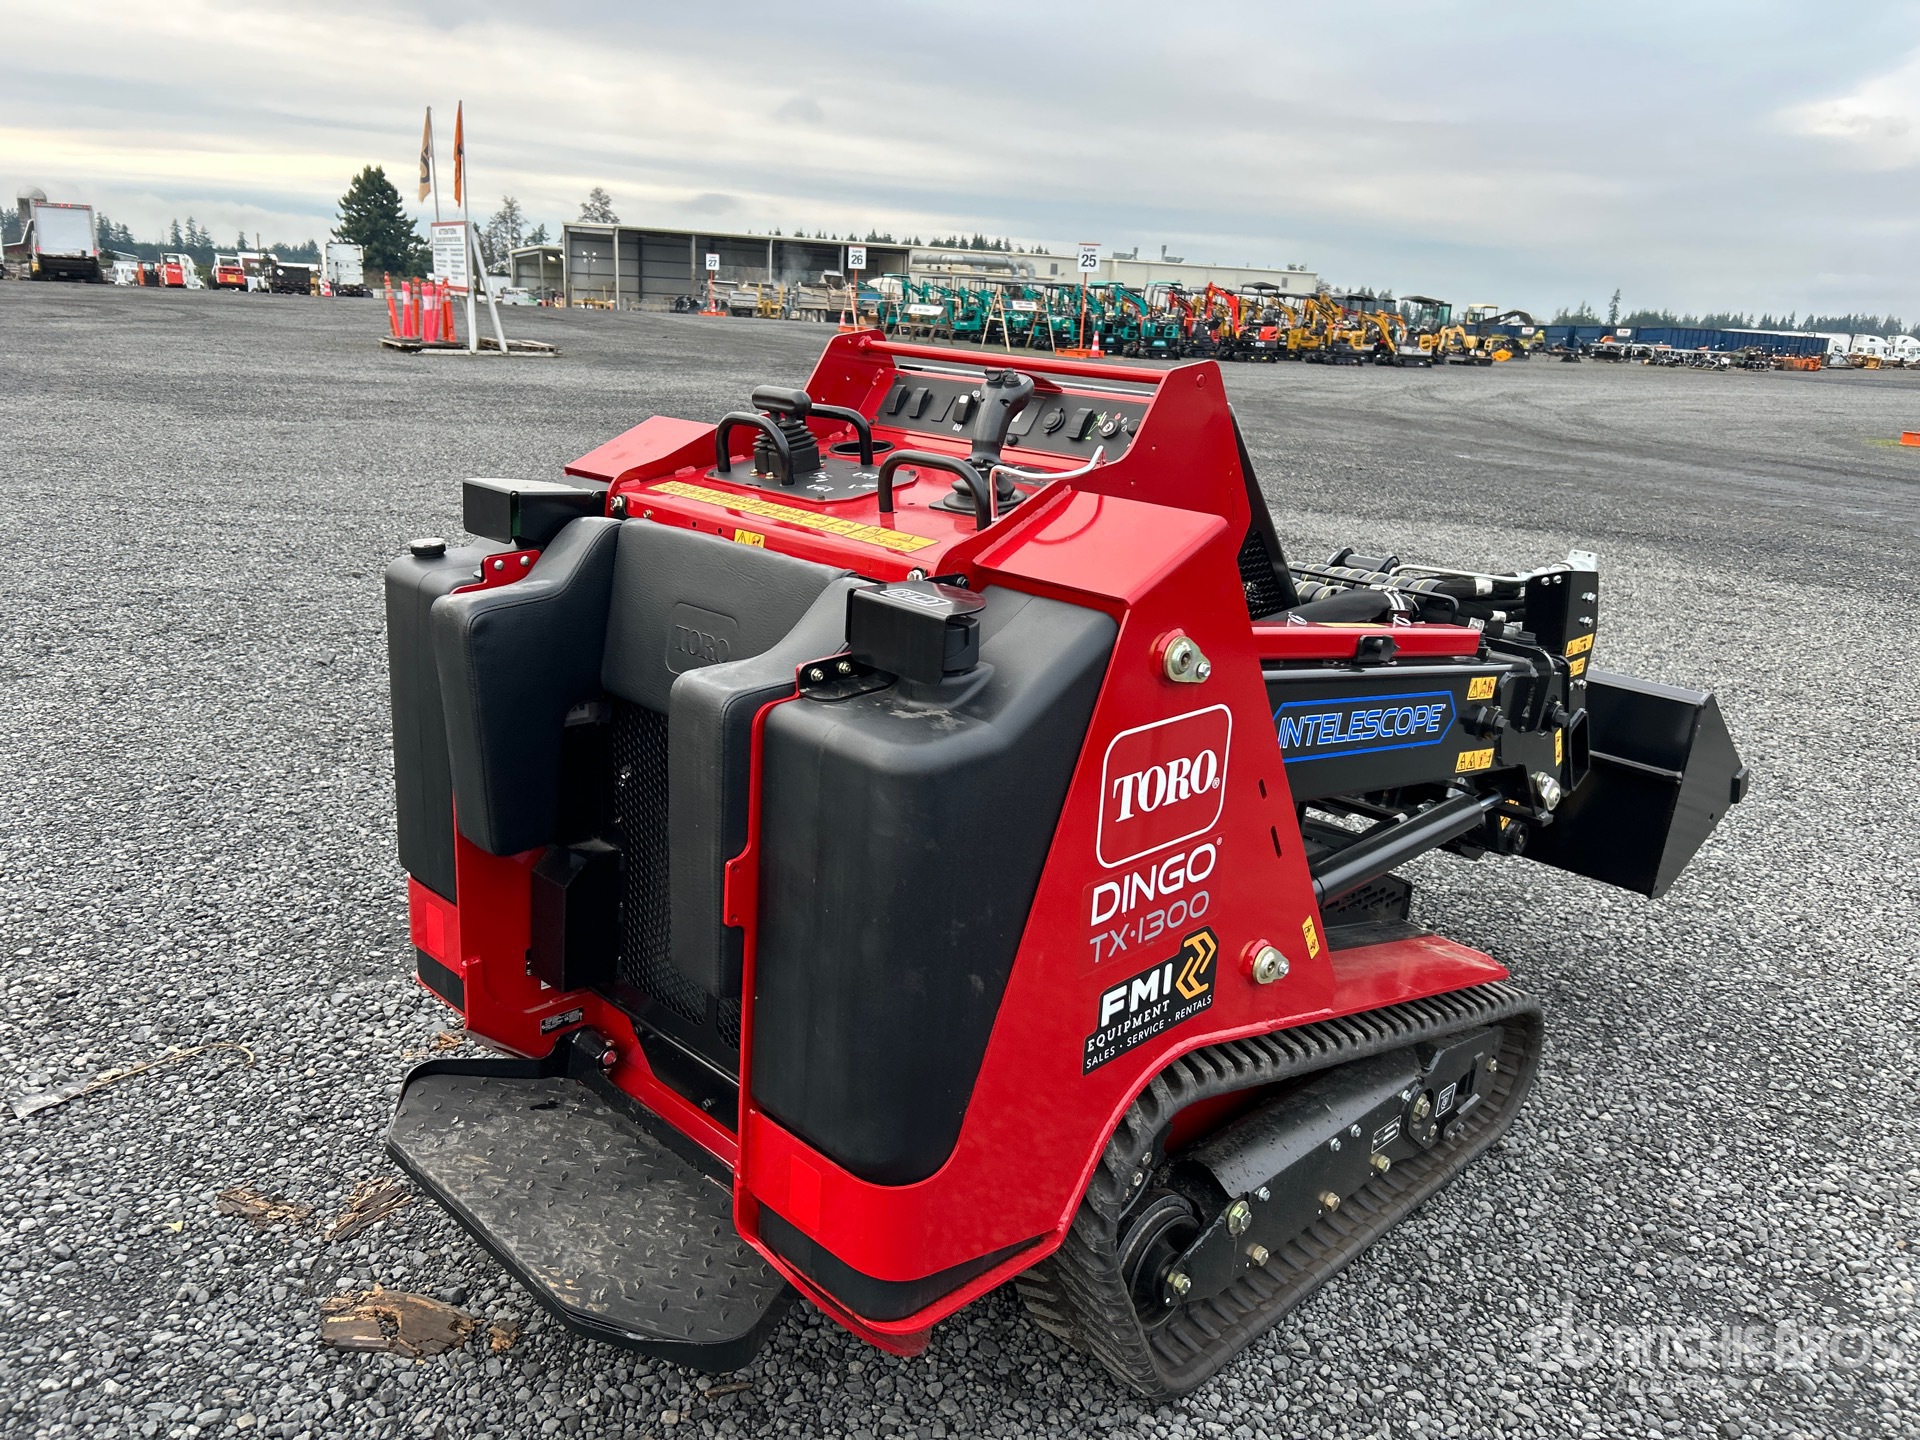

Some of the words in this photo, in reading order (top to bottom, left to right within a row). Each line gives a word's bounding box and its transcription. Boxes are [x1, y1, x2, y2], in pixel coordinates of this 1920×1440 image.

[851, 254, 863, 265] 26
[1081, 254, 1096, 267] 25
[674, 624, 730, 664] TORO
[1277, 704, 1446, 750] INTELESCOPE
[1112, 749, 1218, 822] TORO
[1091, 843, 1216, 926] DINGO
[1101, 963, 1173, 1028] FMI
[1086, 1045, 1115, 1069] SALES
[1126, 1019, 1164, 1047] SERVICE
[1175, 994, 1212, 1021] RENTALS
[1087, 1000, 1170, 1052] EQUIPMENT
